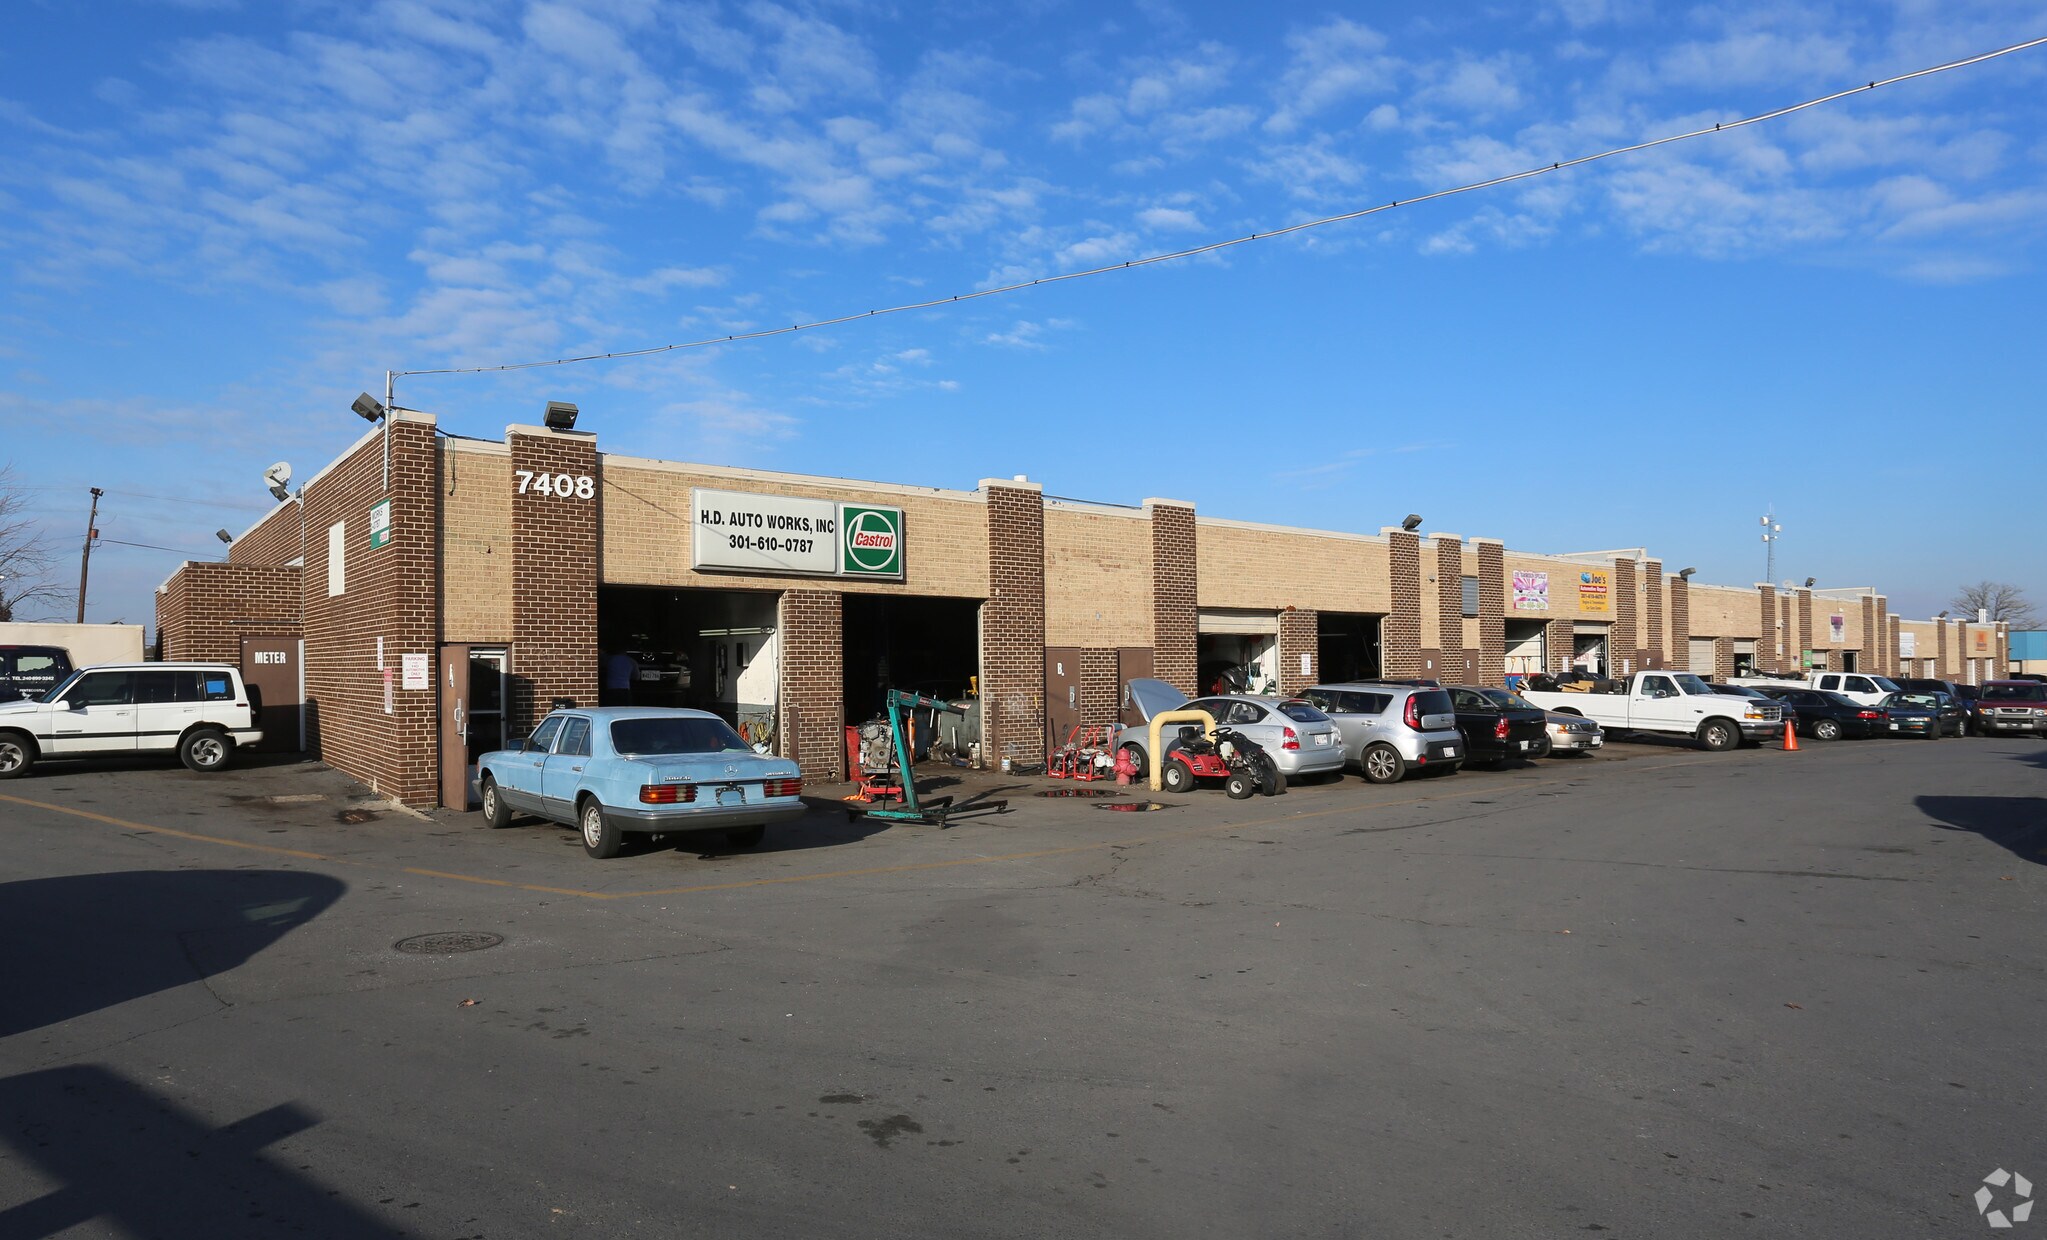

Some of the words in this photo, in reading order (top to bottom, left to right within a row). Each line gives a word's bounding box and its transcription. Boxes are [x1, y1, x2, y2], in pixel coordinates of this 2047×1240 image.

[515, 470, 595, 500] 7408
[700, 509, 725, 526] H.D.
[729, 511, 763, 529] AUTO
[766, 515, 813, 534] WORKS,
[816, 518, 835, 534] INC
[729, 534, 814, 554] 301-610-0787
[854, 531, 894, 548] Castrol
[1591, 572, 1606, 585] Joe's
[254, 651, 286, 664] METER
